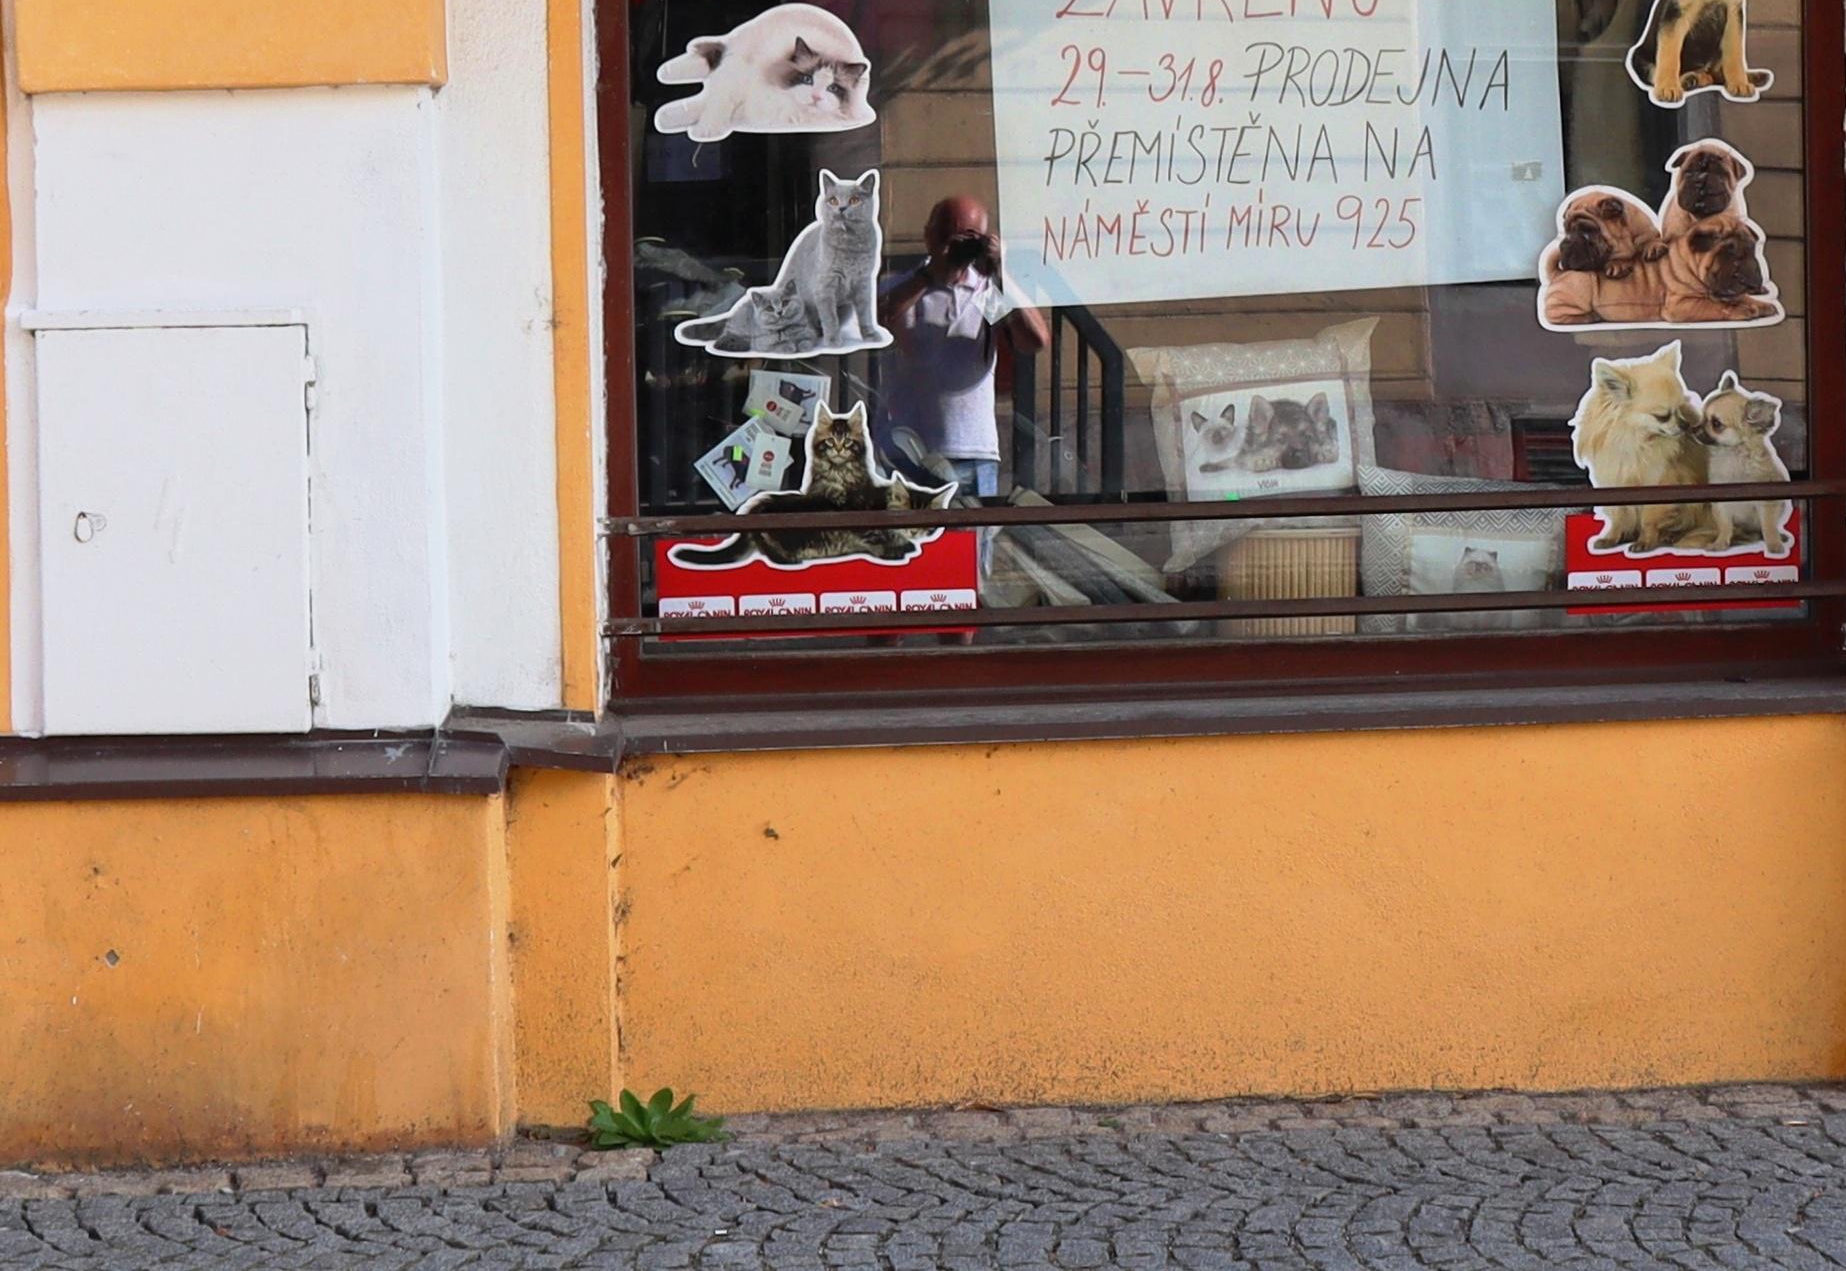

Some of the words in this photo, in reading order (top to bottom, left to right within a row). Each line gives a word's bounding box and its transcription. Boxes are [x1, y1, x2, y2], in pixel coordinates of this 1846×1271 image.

[1243, 41, 1509, 112] PRODEJNA
[1043, 111, 1338, 187] PŘEMÍSTĚNA
[1363, 119, 1438, 182] NA
[1042, 194, 1212, 266] NÁMĚSTÍ
[1225, 188, 1320, 250] MÍRU
[1335, 195, 1423, 251] 925
